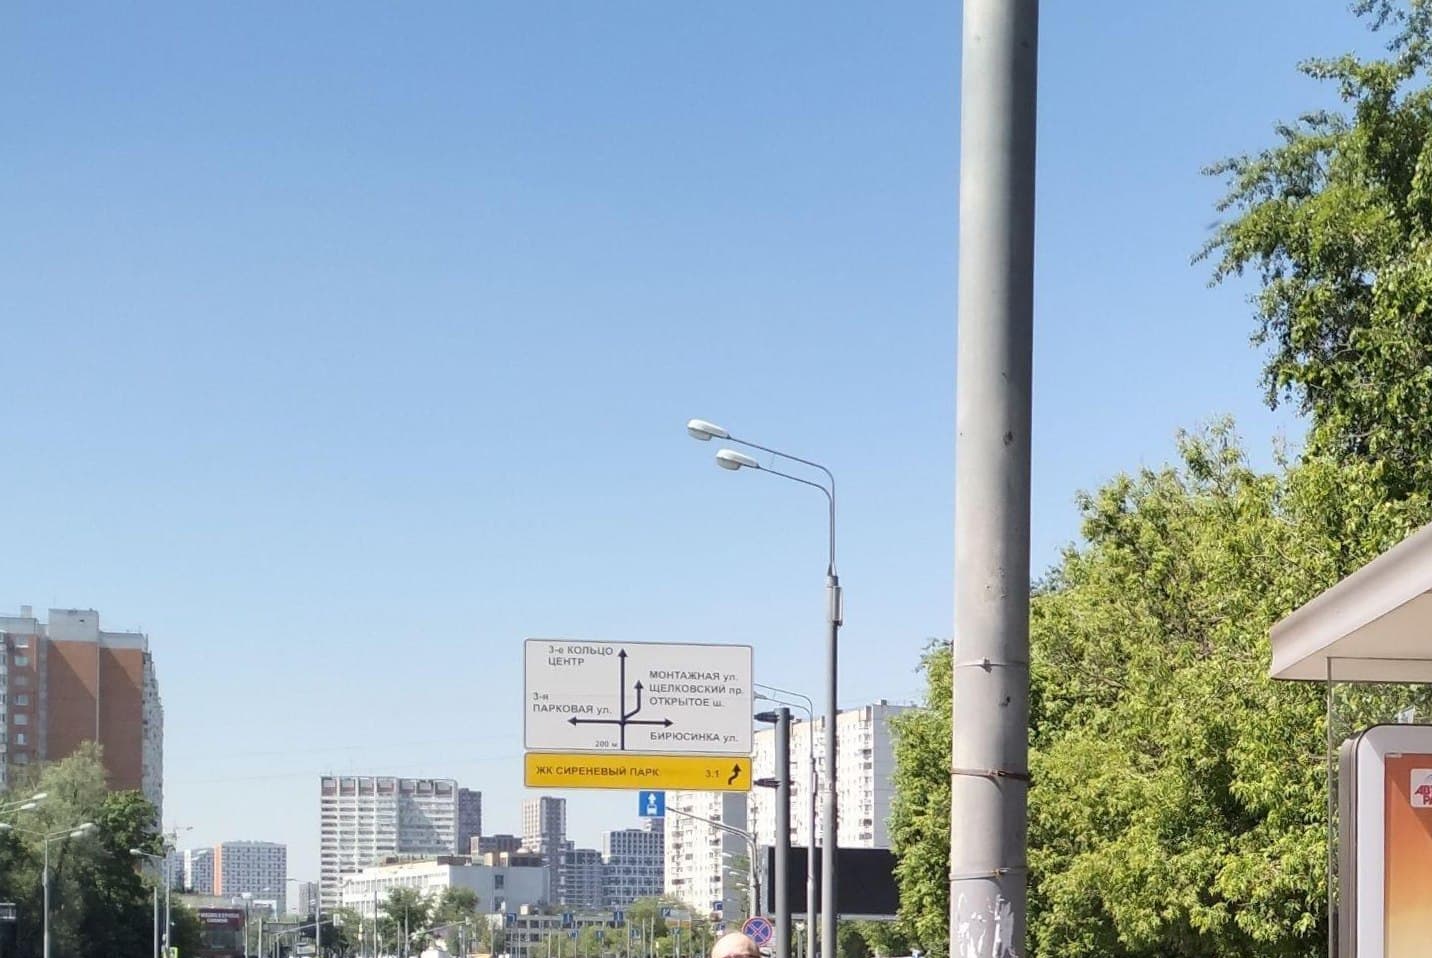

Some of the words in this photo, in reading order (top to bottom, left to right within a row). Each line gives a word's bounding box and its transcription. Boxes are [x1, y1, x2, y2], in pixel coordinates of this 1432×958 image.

[567, 646, 614, 656] КОЛЬЦО
[548, 657, 585, 666] ЦЕНТР
[649, 671, 720, 681] МОНТАЖНАЯ
[722, 674, 739, 683] ул.
[649, 684, 726, 695] ЩЕЛКОВСКИЙ
[649, 696, 710, 707] ОТКРЫТОЕ
[532, 703, 594, 714] ПАРКОВАЯ
[596, 706, 613, 716] ул.
[650, 731, 720, 741] БИРЮСИНКА
[723, 734, 740, 744] ул.
[536, 766, 552, 775] ЖК
[555, 765, 627, 776] СИРЕНЕВЫЙ
[629, 767, 660, 777] ПАРК
